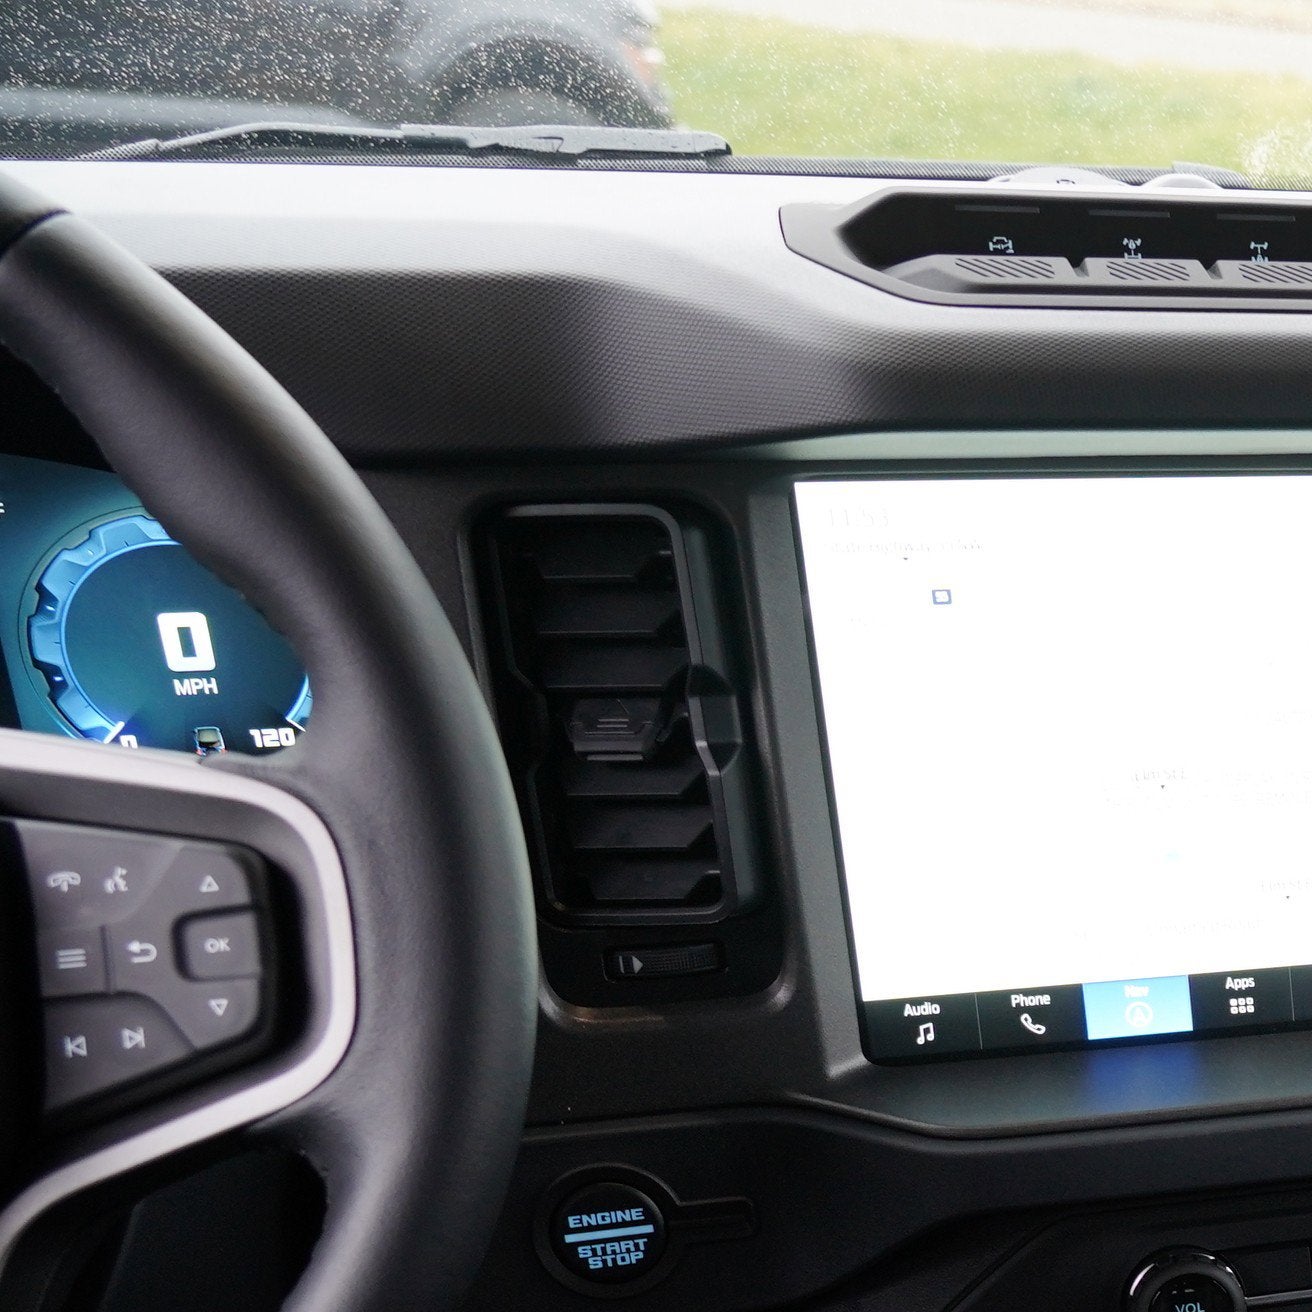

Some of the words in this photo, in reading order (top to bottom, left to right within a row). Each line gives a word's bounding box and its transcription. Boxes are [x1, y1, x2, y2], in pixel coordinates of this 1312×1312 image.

[157, 611, 216, 672] 0
[173, 678, 219, 696] MPH
[249, 727, 296, 748] 120
[204, 937, 231, 953] OK
[1225, 976, 1256, 990] Apps
[903, 1001, 940, 1017] Audio
[1010, 993, 1051, 1008] Phone
[568, 1207, 645, 1229] ENGINE
[577, 1238, 648, 1258] START
[588, 1251, 644, 1269] STOP
